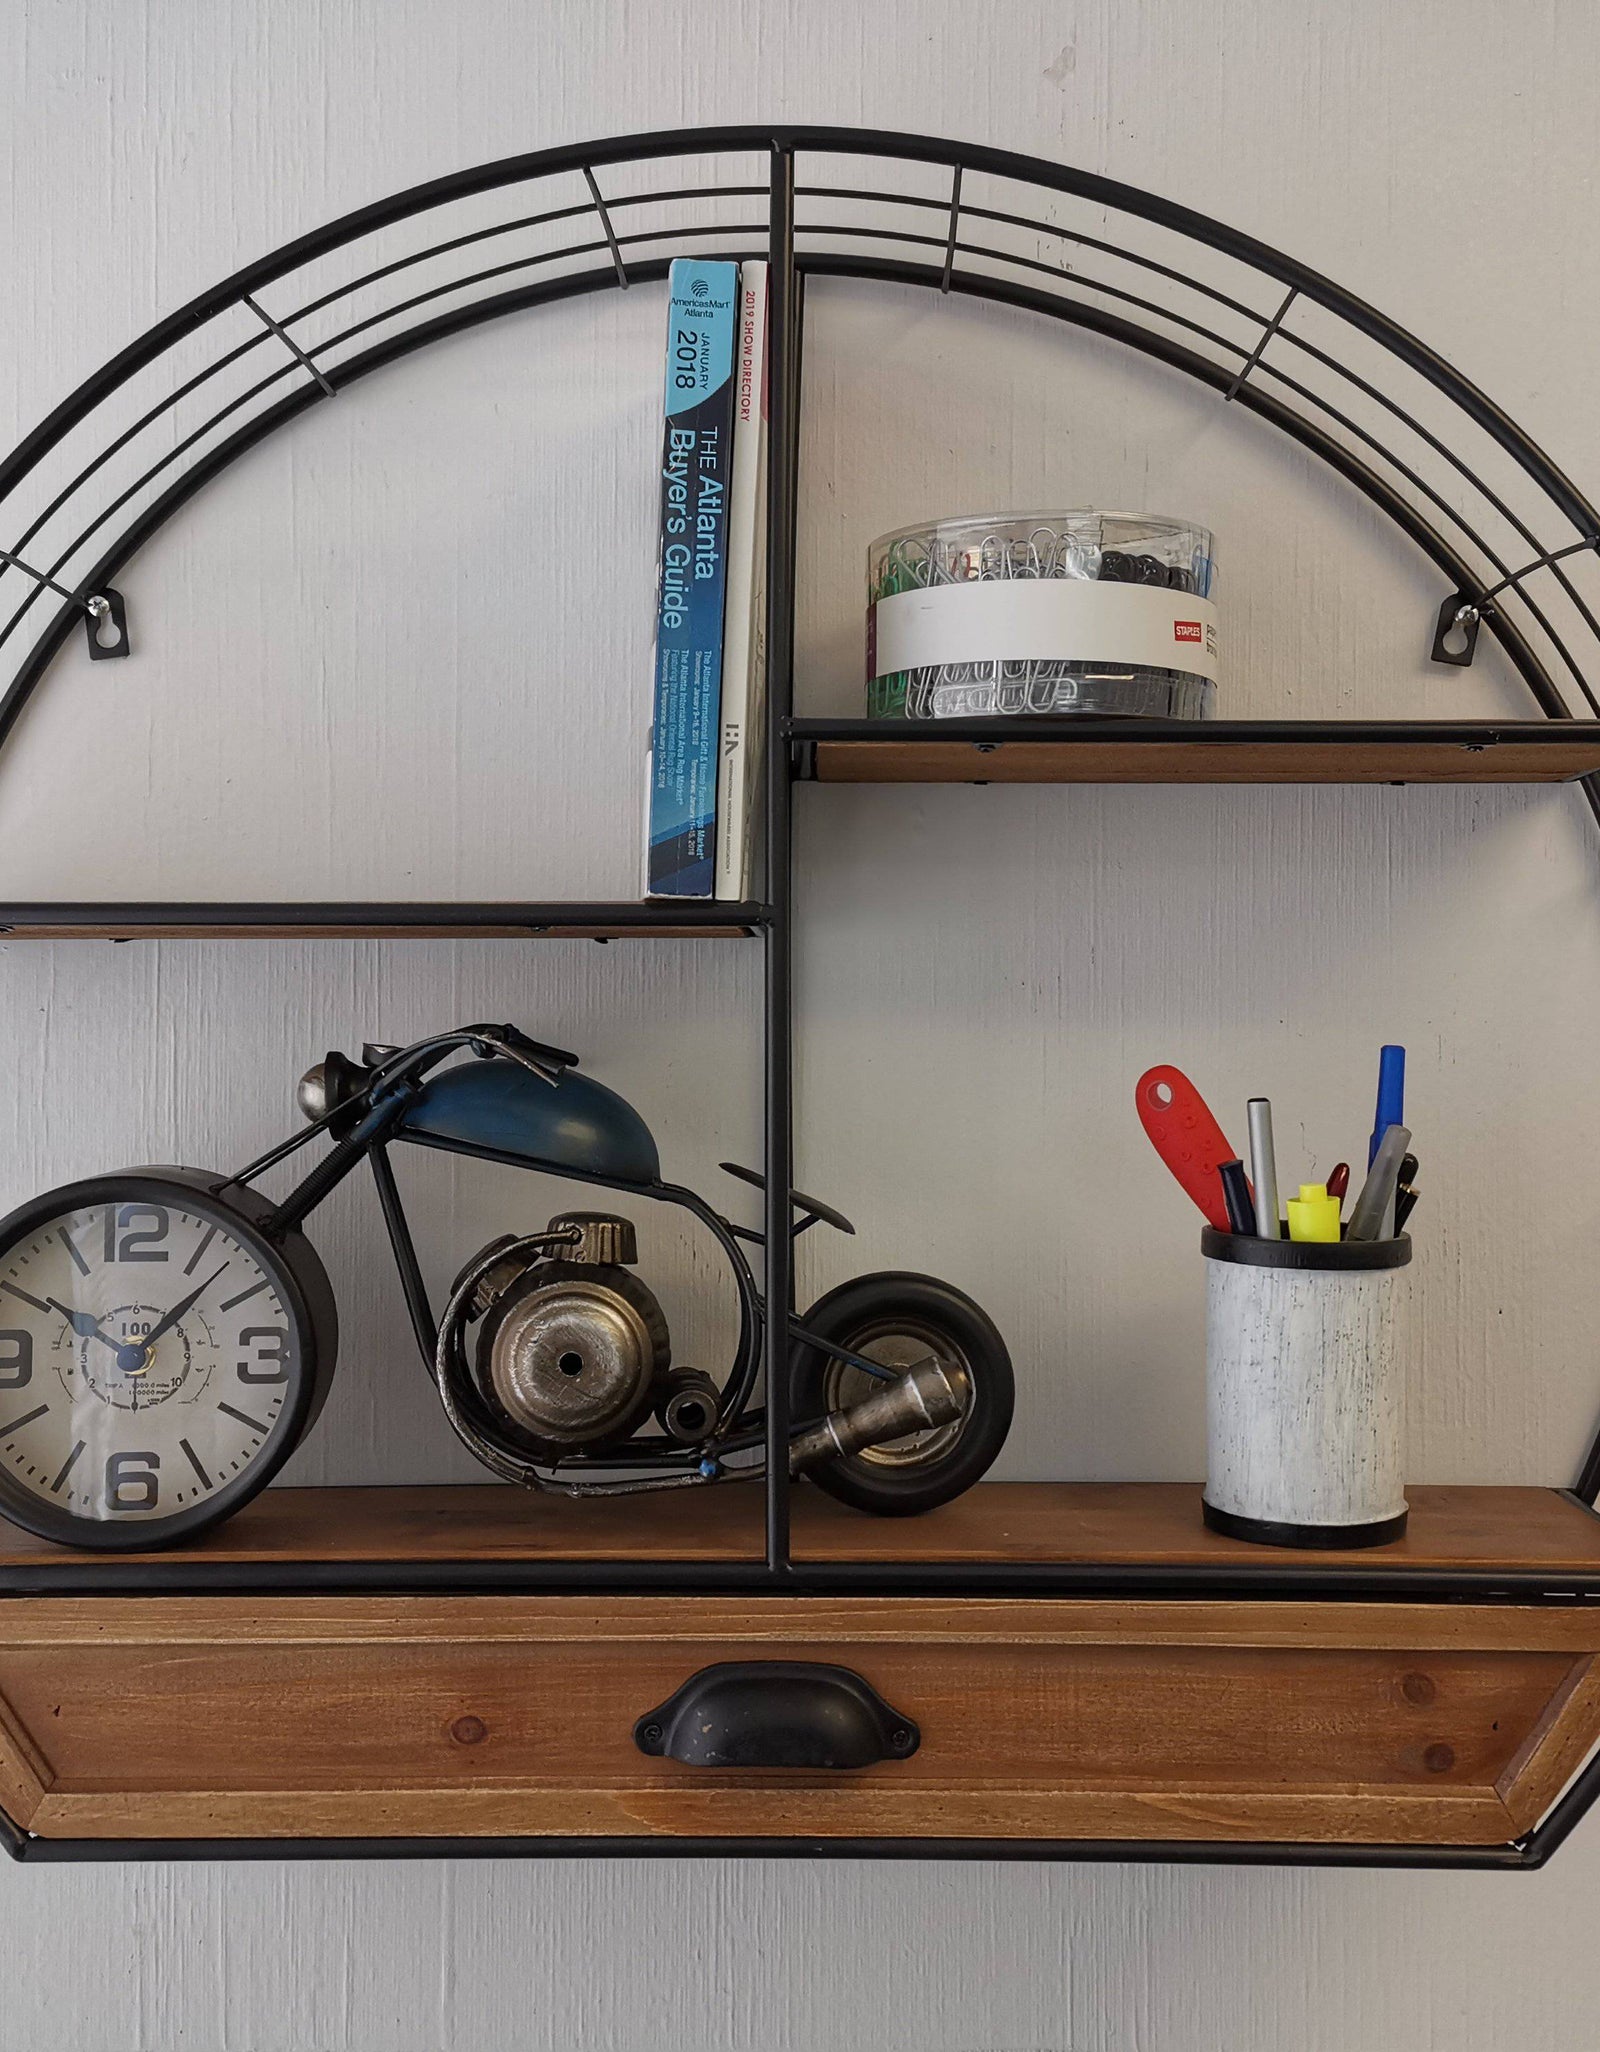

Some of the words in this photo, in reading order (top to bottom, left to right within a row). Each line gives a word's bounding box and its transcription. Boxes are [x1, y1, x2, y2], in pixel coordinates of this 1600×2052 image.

[684, 309, 713, 318] Atlanta
[745, 291, 756, 318] 2019
[743, 322, 754, 356] SHOW
[675, 330, 697, 389] 2018
[699, 332, 710, 390] JANUARY
[740, 359, 752, 422] DIRECTORY
[699, 426, 718, 469] THE
[662, 428, 695, 534] Buyer's
[695, 475, 724, 580] Atlanta
[663, 544, 691, 629] Guide
[1176, 626, 1200, 636] STAPLES
[670, 649, 679, 681] Featuring
[681, 649, 689, 664] The
[704, 650, 712, 664] The
[680, 665, 688, 691] Atlanta
[702, 667, 711, 692] Atlanta
[669, 695, 678, 723] National
[678, 693, 687, 738] International
[701, 693, 710, 740] International
[659, 727, 667, 750] January
[668, 725, 676, 750] Oriental
[667, 752, 675, 765] Rug
[676, 759, 685, 773] Rug
[667, 766, 675, 787] Show
[699, 763, 707, 785] Home
[697, 786, 706, 828] Furnishings
[104, 1204, 169, 1262] 12
[107, 1313, 114, 1321] 5
[133, 1305, 140, 1314] 6
[122, 1323, 150, 1336] 100
[177, 1328, 184, 1338] 8
[81, 1354, 87, 1363] 3
[183, 1352, 191, 1363] 9
[237, 1327, 289, 1384] 3
[89, 1379, 95, 1388] 2
[171, 1377, 182, 1386] 10
[105, 1451, 161, 1510] 6
